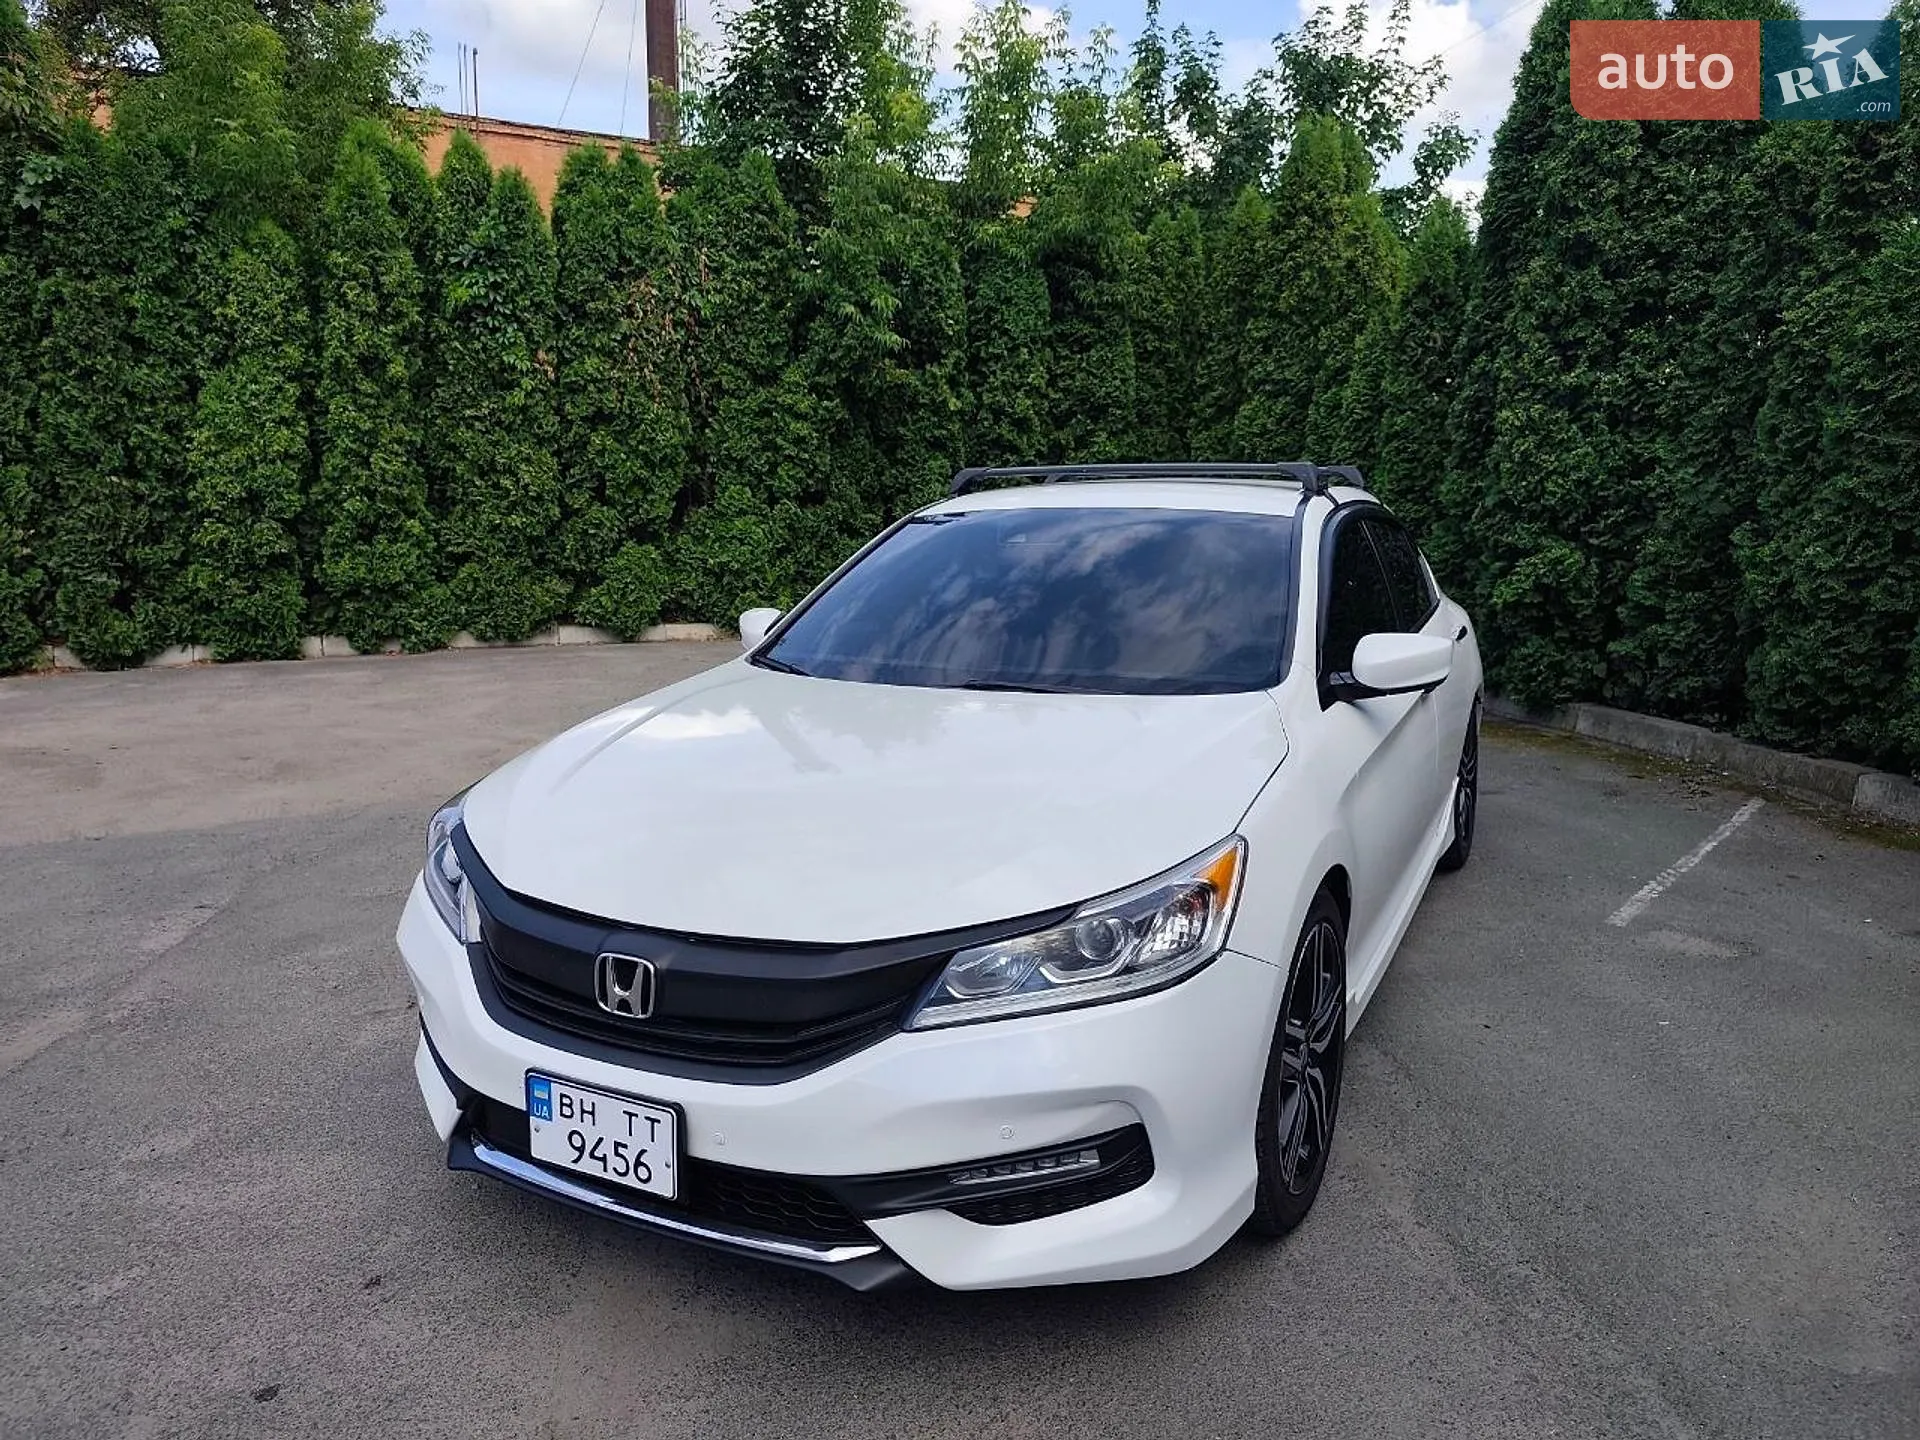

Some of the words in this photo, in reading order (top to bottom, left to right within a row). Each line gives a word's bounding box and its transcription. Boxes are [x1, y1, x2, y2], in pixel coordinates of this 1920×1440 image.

[533, 1102, 550, 1118] UA
[559, 1092, 596, 1126] BH
[622, 1110, 661, 1143] TT
[567, 1129, 653, 1184] 9456
